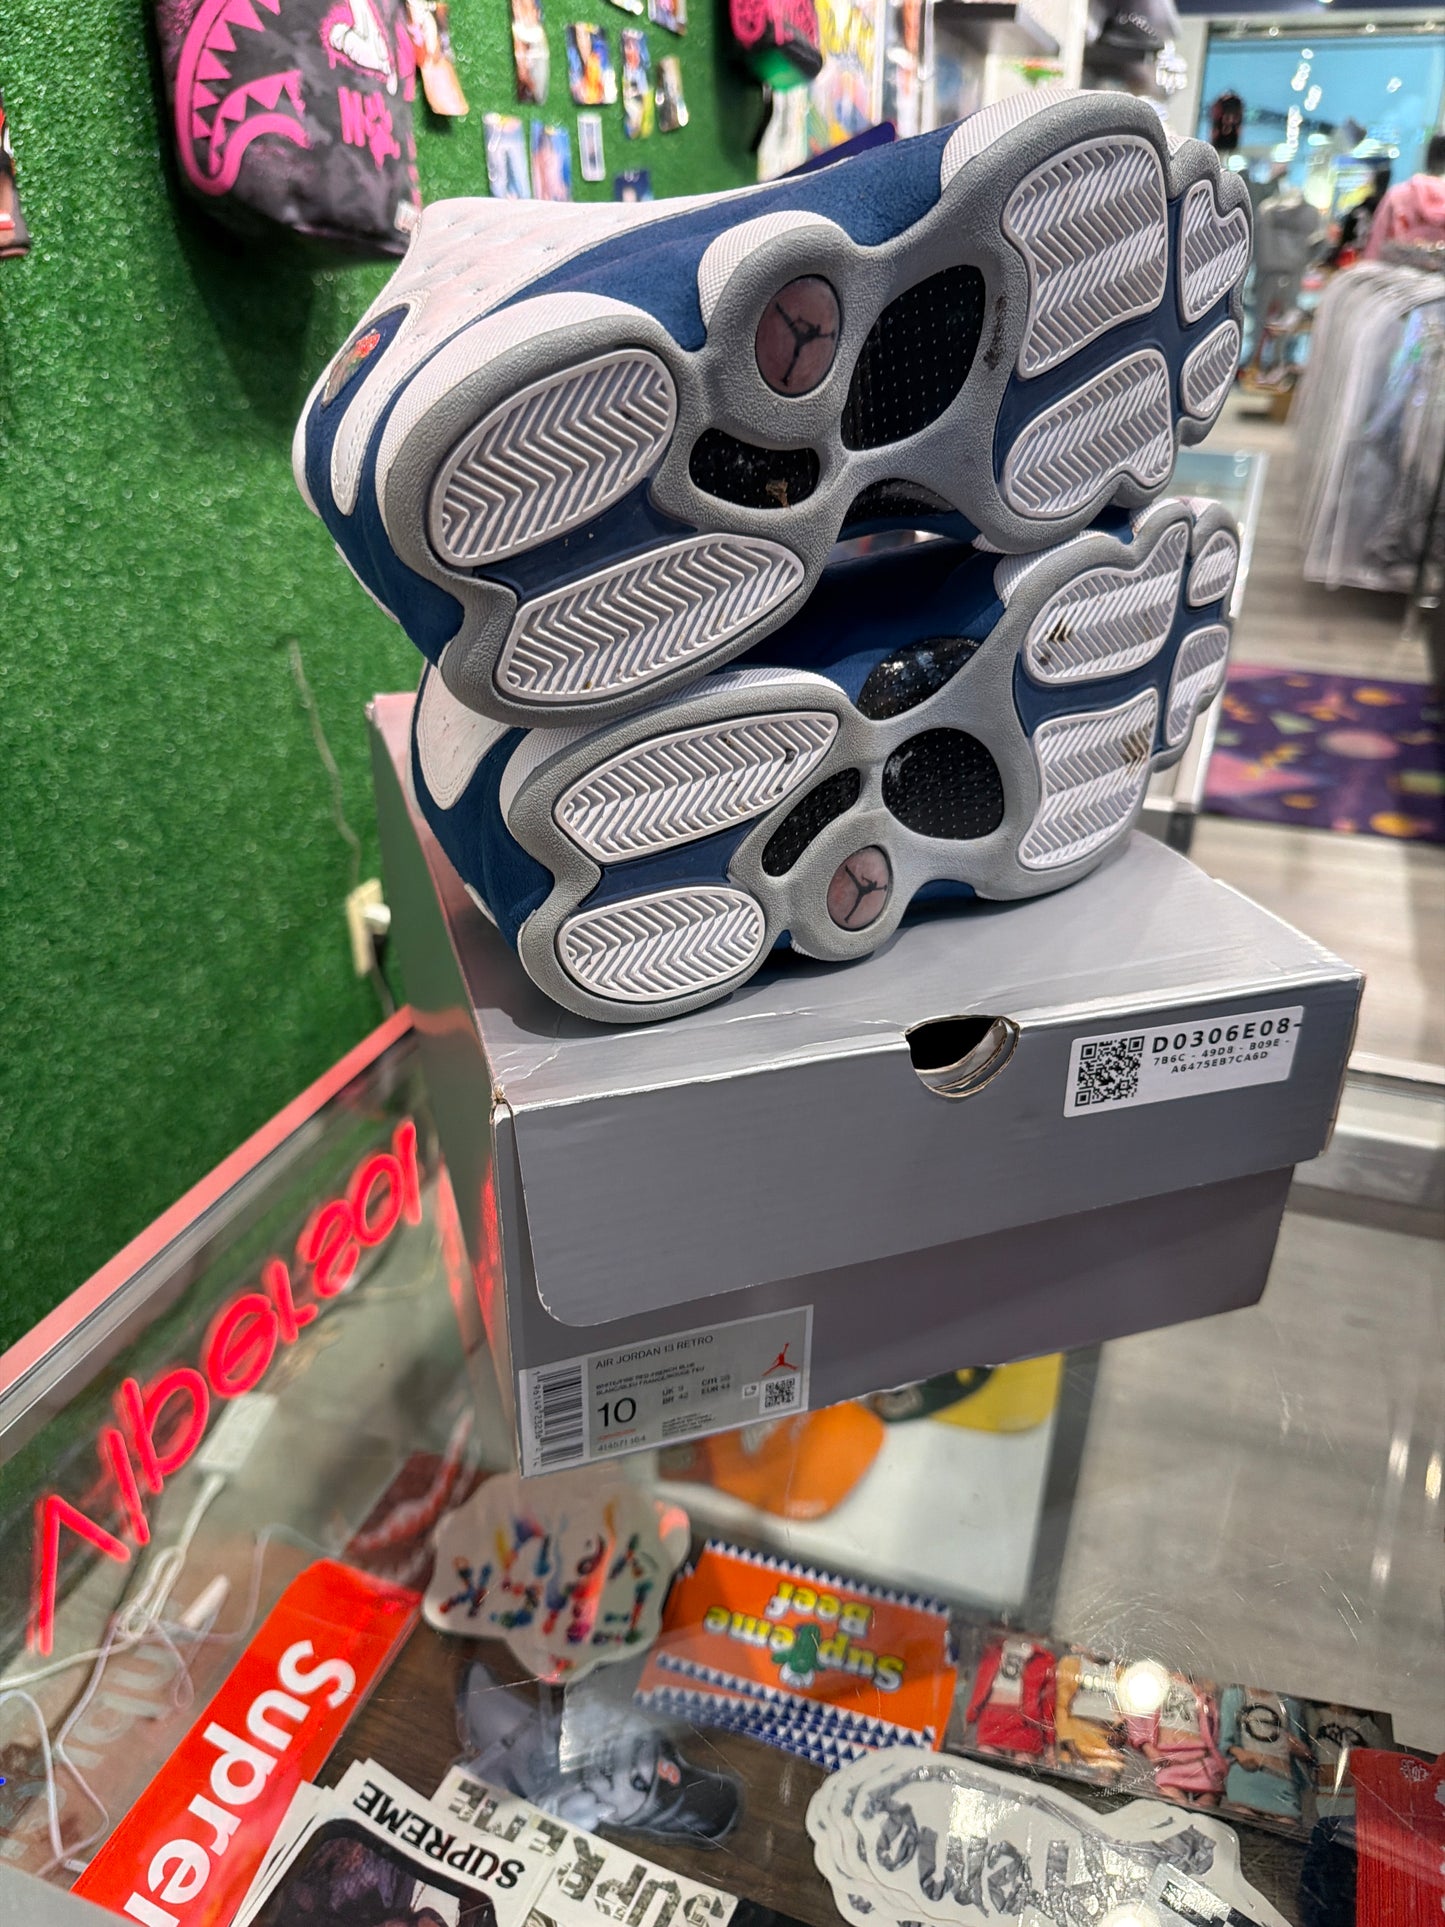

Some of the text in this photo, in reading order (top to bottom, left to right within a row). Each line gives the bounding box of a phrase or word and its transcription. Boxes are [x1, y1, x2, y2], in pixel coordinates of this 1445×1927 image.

[1151, 1017, 1303, 1054] D0306E08-
[595, 1357, 614, 1370] AIR
[616, 1347, 662, 1365] JORDAN
[676, 1335, 714, 1350] RETRO
[597, 1397, 637, 1427] 10
[352, 1779, 527, 1890] SUPREME
